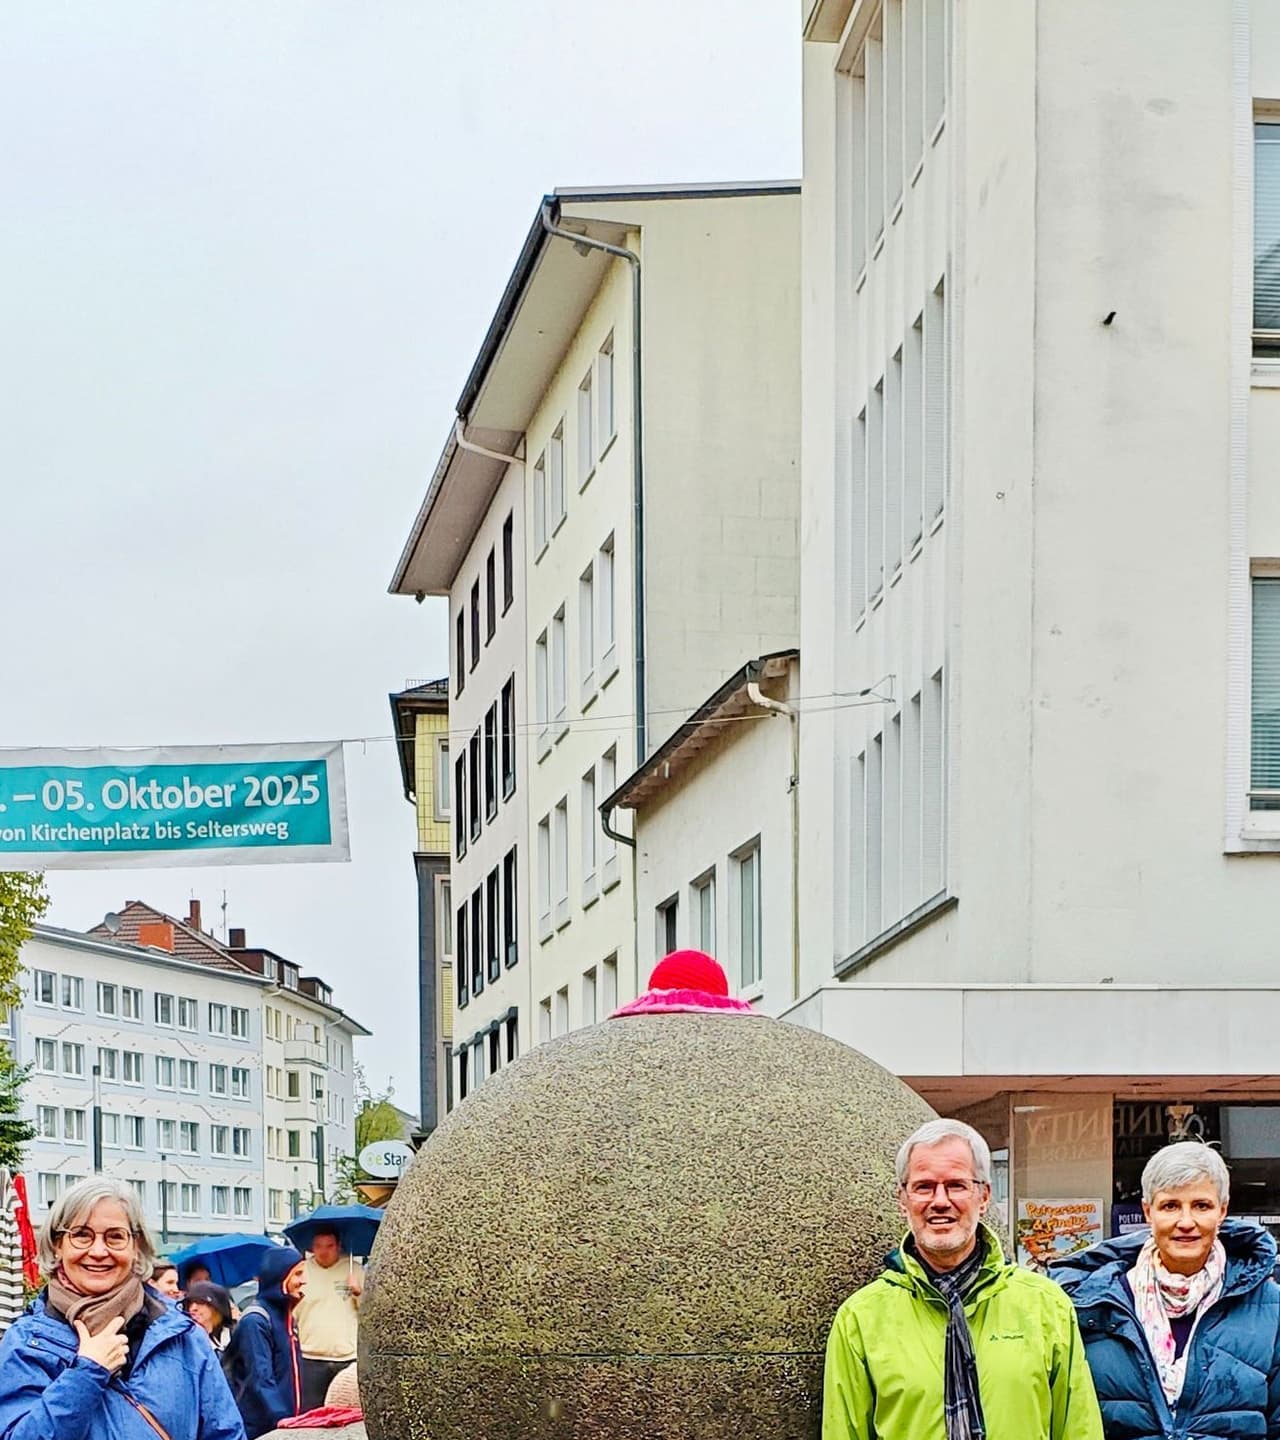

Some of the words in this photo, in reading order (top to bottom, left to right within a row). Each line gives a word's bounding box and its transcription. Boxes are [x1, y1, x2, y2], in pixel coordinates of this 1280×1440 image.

[41, 778, 94, 812] 05.
[101, 776, 237, 811] Oktober
[242, 773, 320, 808] 2025
[31, 821, 150, 846] Kirchenplatz
[155, 820, 181, 839] bis
[186, 819, 289, 841] Seltersweg
[1118, 1214, 1143, 1225] POETRY
